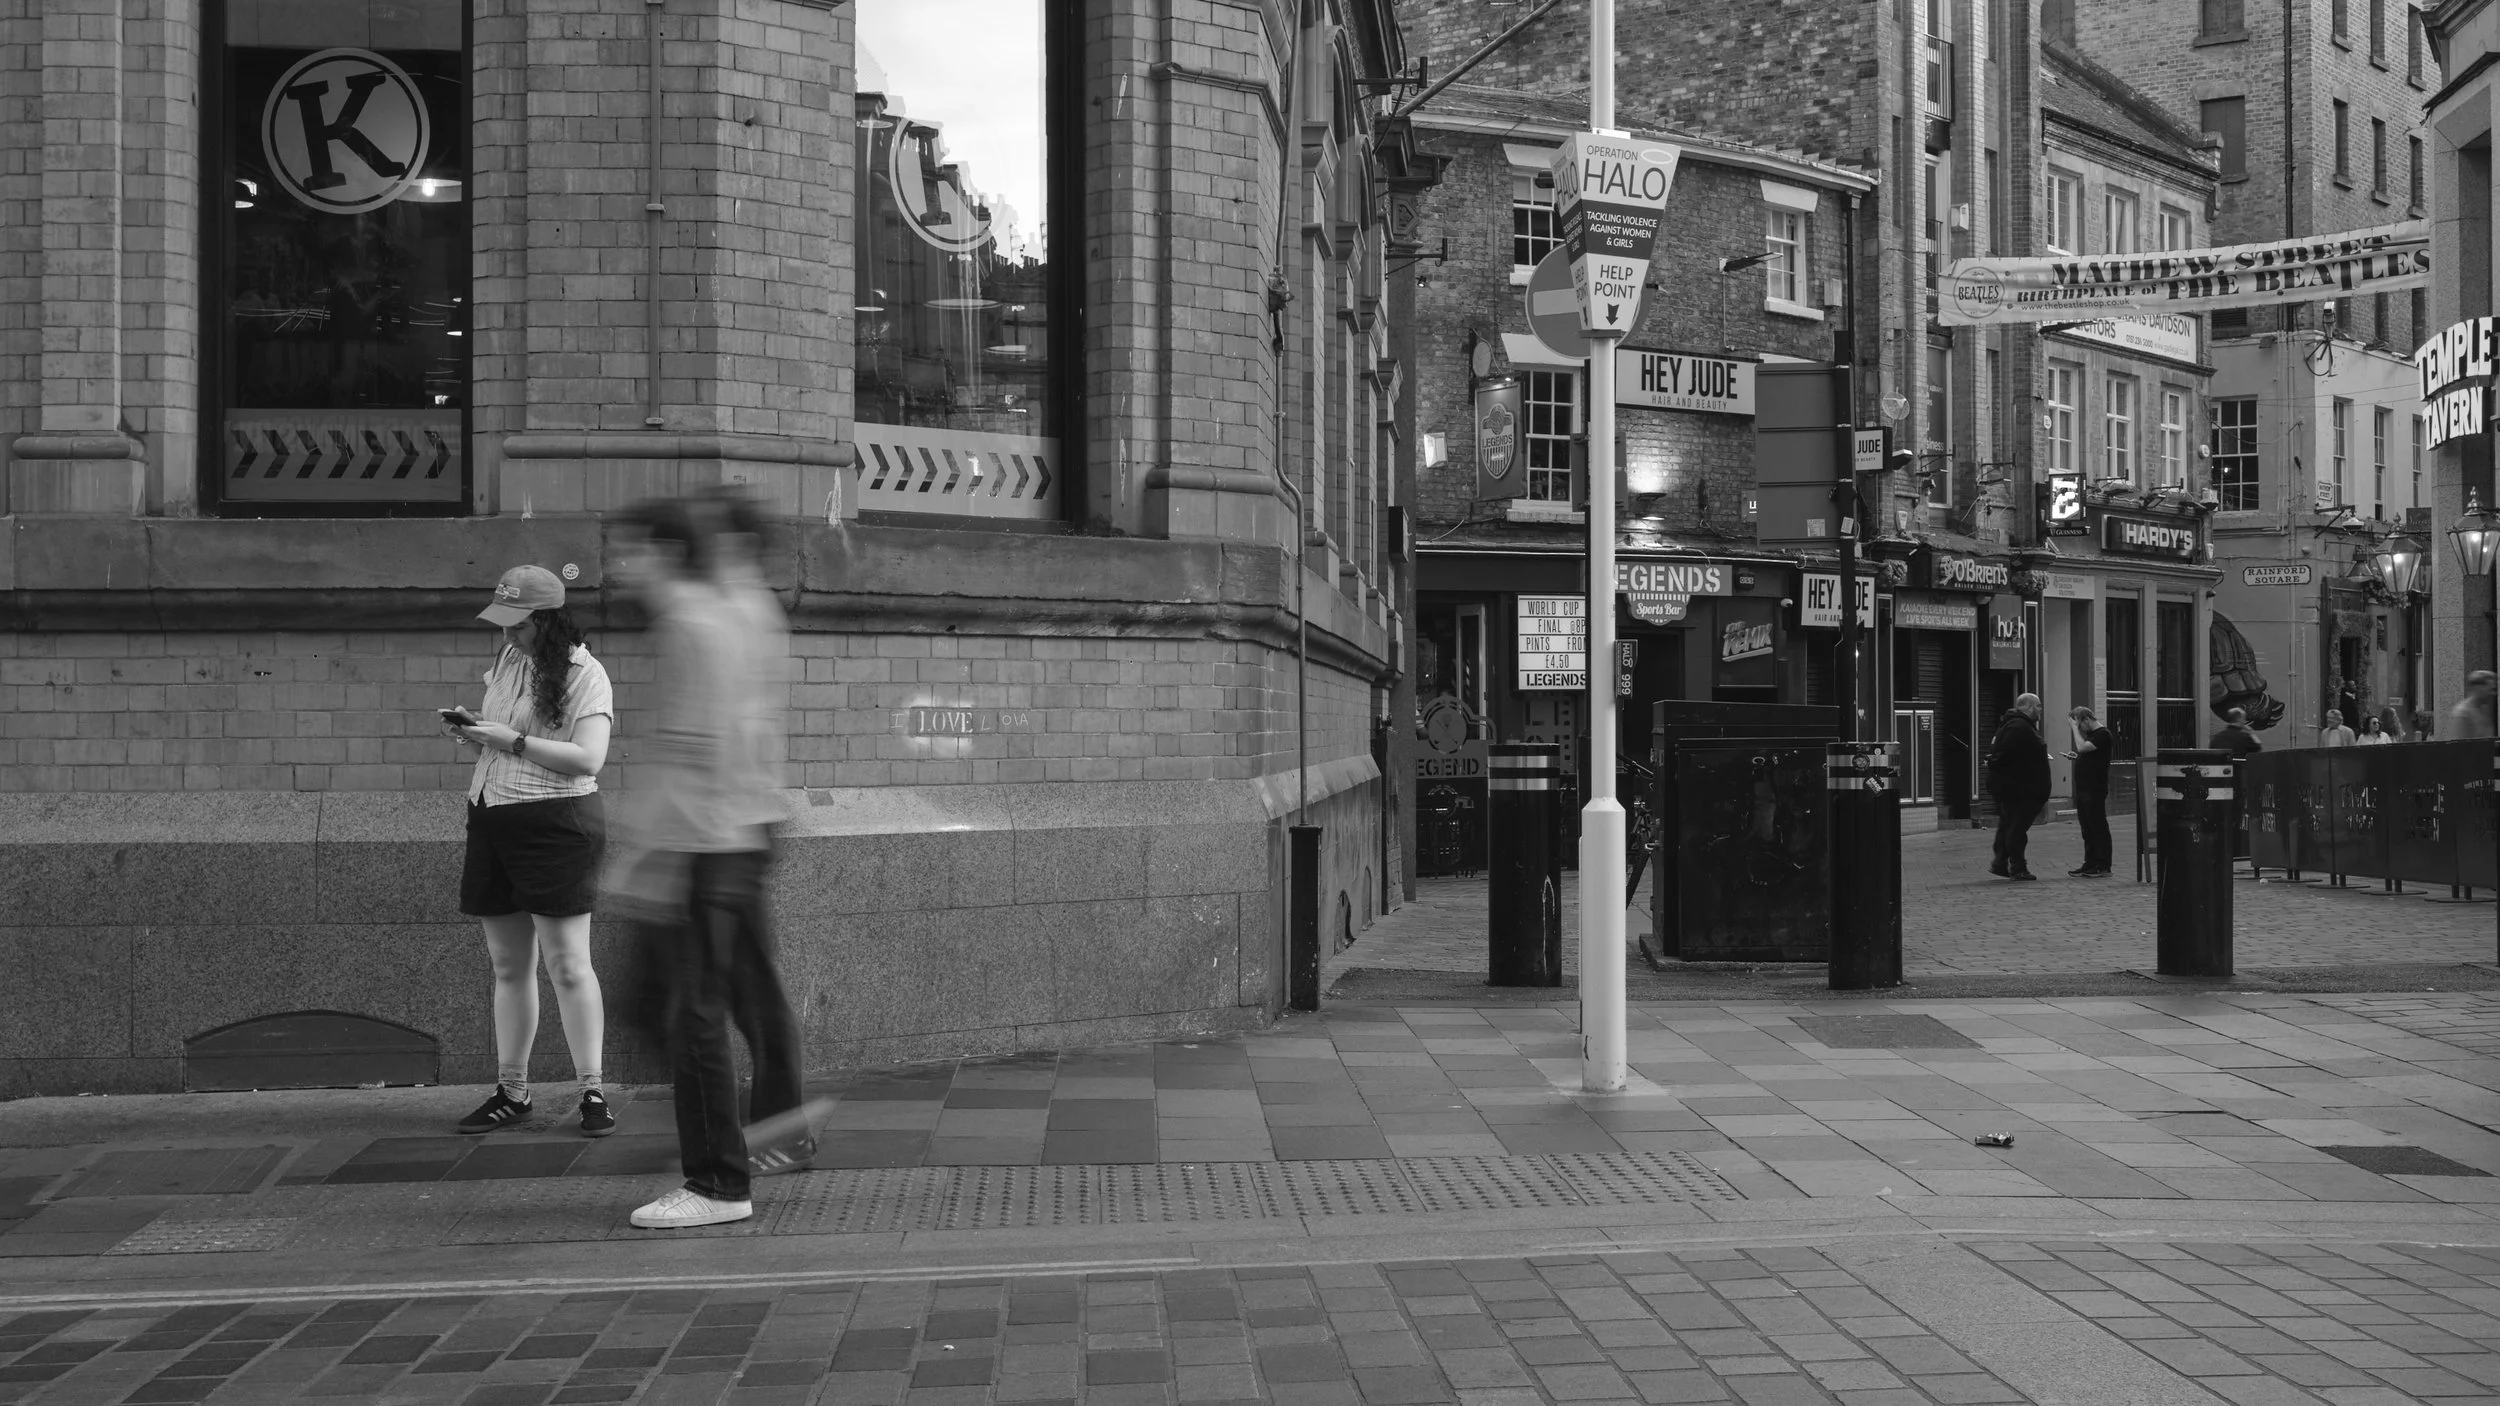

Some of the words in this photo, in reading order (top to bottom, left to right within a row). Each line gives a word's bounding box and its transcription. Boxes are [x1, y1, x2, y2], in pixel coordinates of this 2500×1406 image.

[286, 70, 406, 192] K
[1586, 145, 1638, 161] OPERATION
[1556, 161, 1579, 208] HALO
[1583, 158, 1666, 201] HALO
[1586, 211, 1621, 224] TACKLING
[1622, 215, 1658, 228] VIOLENCE
[1590, 223, 1621, 236] AGAINST
[1622, 228, 1652, 239] WOMEN
[1606, 237, 1612, 246] &
[1613, 238, 1634, 249] GIRLS
[2050, 253, 2224, 286] MATHEW
[2234, 234, 2392, 271] STREET
[1600, 264, 1633, 281] HELP
[2017, 285, 2136, 302] BIRTHPLACE
[2163, 273, 2240, 300] THE
[2254, 247, 2430, 293] BEATLES
[1594, 282, 1636, 299] POINT
[1958, 284, 2000, 303] BEATLES
[2021, 297, 2131, 311] www.thebeatleshop.co.uk
[2149, 313, 2191, 338] DAVIDSON
[2415, 317, 2493, 401] TEMPLE
[1641, 354, 1682, 394] HEY
[1688, 359, 1738, 400] JUDE
[1651, 395, 1672, 406] HAIR
[1676, 397, 1692, 408] AND
[1696, 398, 1728, 411] BEAUTY
[2422, 386, 2483, 451] TAVERN
[1482, 434, 1513, 449] LEGENDS
[1857, 439, 1881, 454] JUDE
[2125, 522, 2193, 551] HARDY'S
[1614, 564, 1721, 593] EGENDS
[2248, 567, 2307, 576] RAINFORD
[2254, 575, 2300, 584] SQUARE
[1808, 578, 1836, 610] HEY
[1527, 600, 1557, 616] WORLD
[1563, 601, 1580, 616] CUP
[1636, 602, 1665, 618] Sports
[1664, 602, 1683, 616] Bar
[1538, 618, 1562, 634] FINAL
[1570, 618, 1586, 635] @8P
[1526, 636, 1551, 651] PINTS
[1567, 637, 1586, 651] FRO
[1545, 654, 1570, 669] £4.50
[1622, 643, 1631, 667] HALO
[1526, 673, 1586, 687] LEGENDS
[1621, 673, 1631, 695] 999
[891, 713, 905, 729] I
[919, 710, 973, 733] LOVE
[1416, 758, 1487, 776] EGEND
